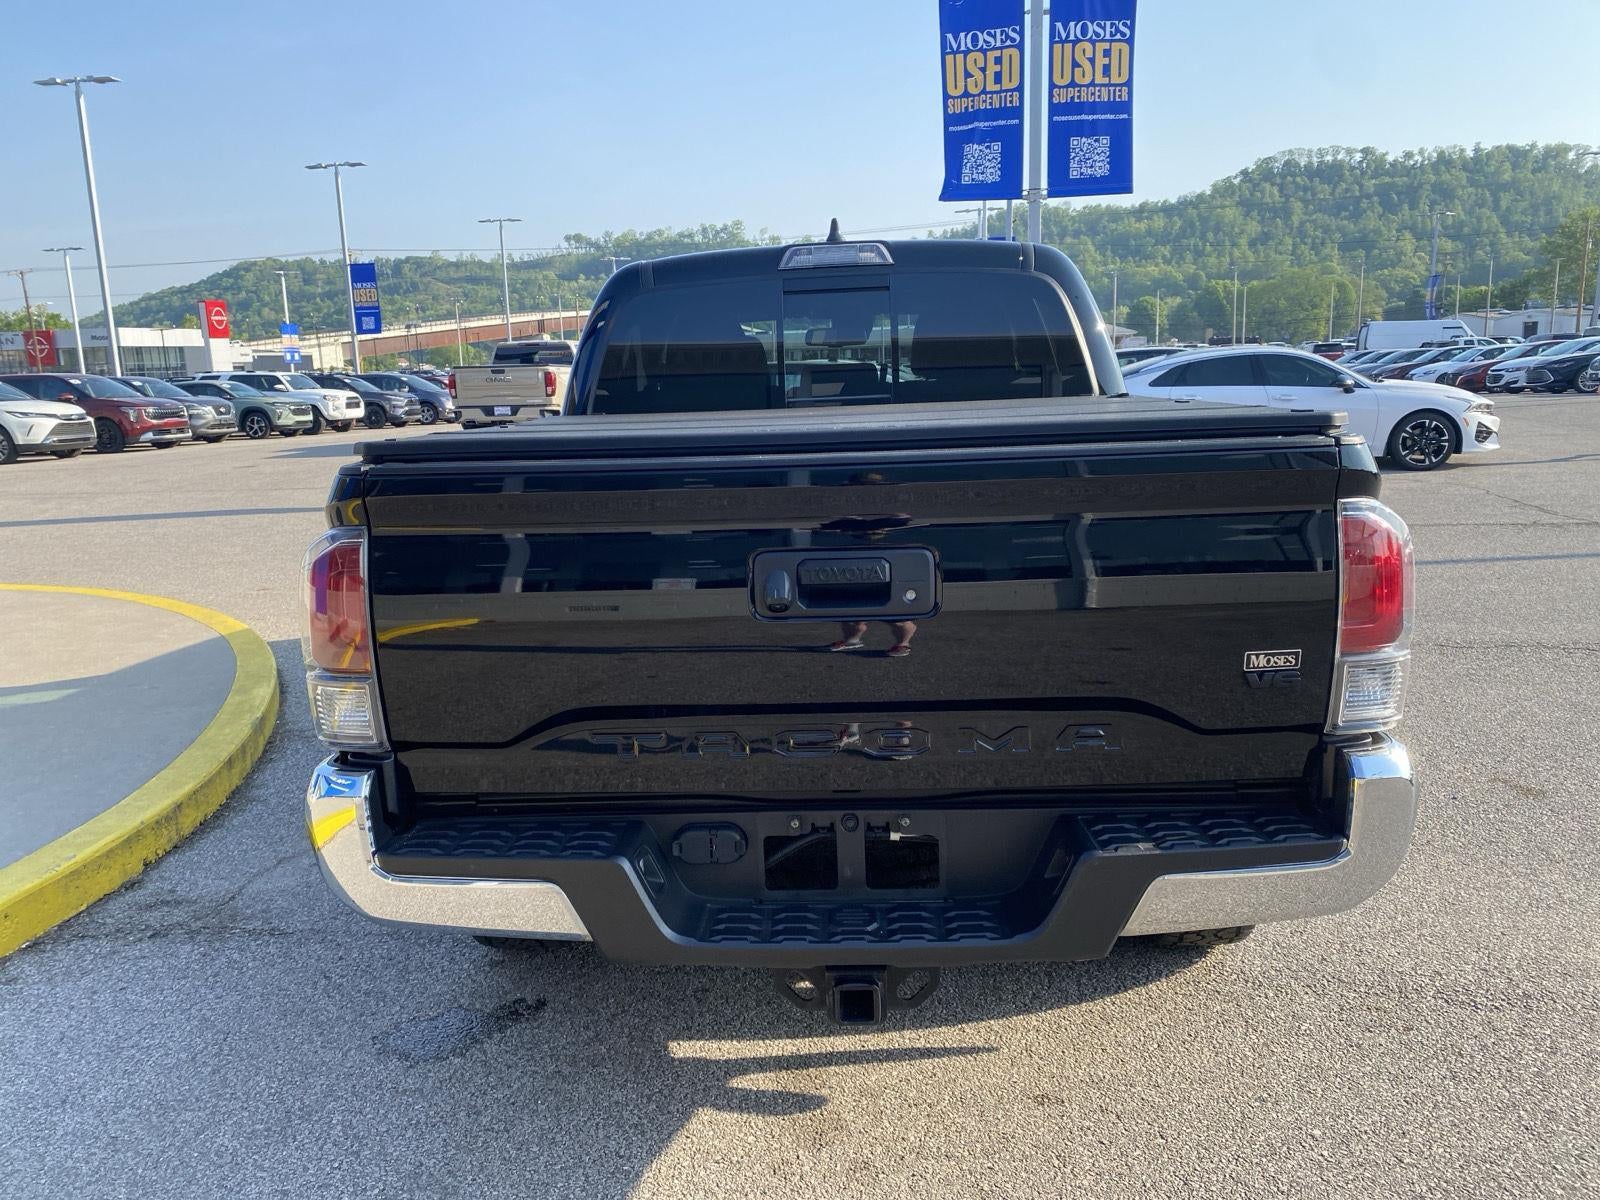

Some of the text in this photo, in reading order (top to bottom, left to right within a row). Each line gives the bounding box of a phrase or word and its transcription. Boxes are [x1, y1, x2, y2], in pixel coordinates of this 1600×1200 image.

[945, 26, 1020, 52] MOSES
[1054, 20, 1131, 41] MOSES
[945, 48, 1020, 96] USED
[1053, 42, 1130, 86] USED
[947, 92, 1020, 114] SUPERCENTER
[1053, 87, 1129, 104] SUPERCENTER
[1053, 114, 1129, 122] mosesusedsupercenter.com
[353, 288, 378, 302] USED
[802, 565, 885, 582] TOYOTA
[1249, 654, 1296, 668] MOSES
[1245, 671, 1302, 688] V6
[591, 723, 1124, 760] TACOMA
